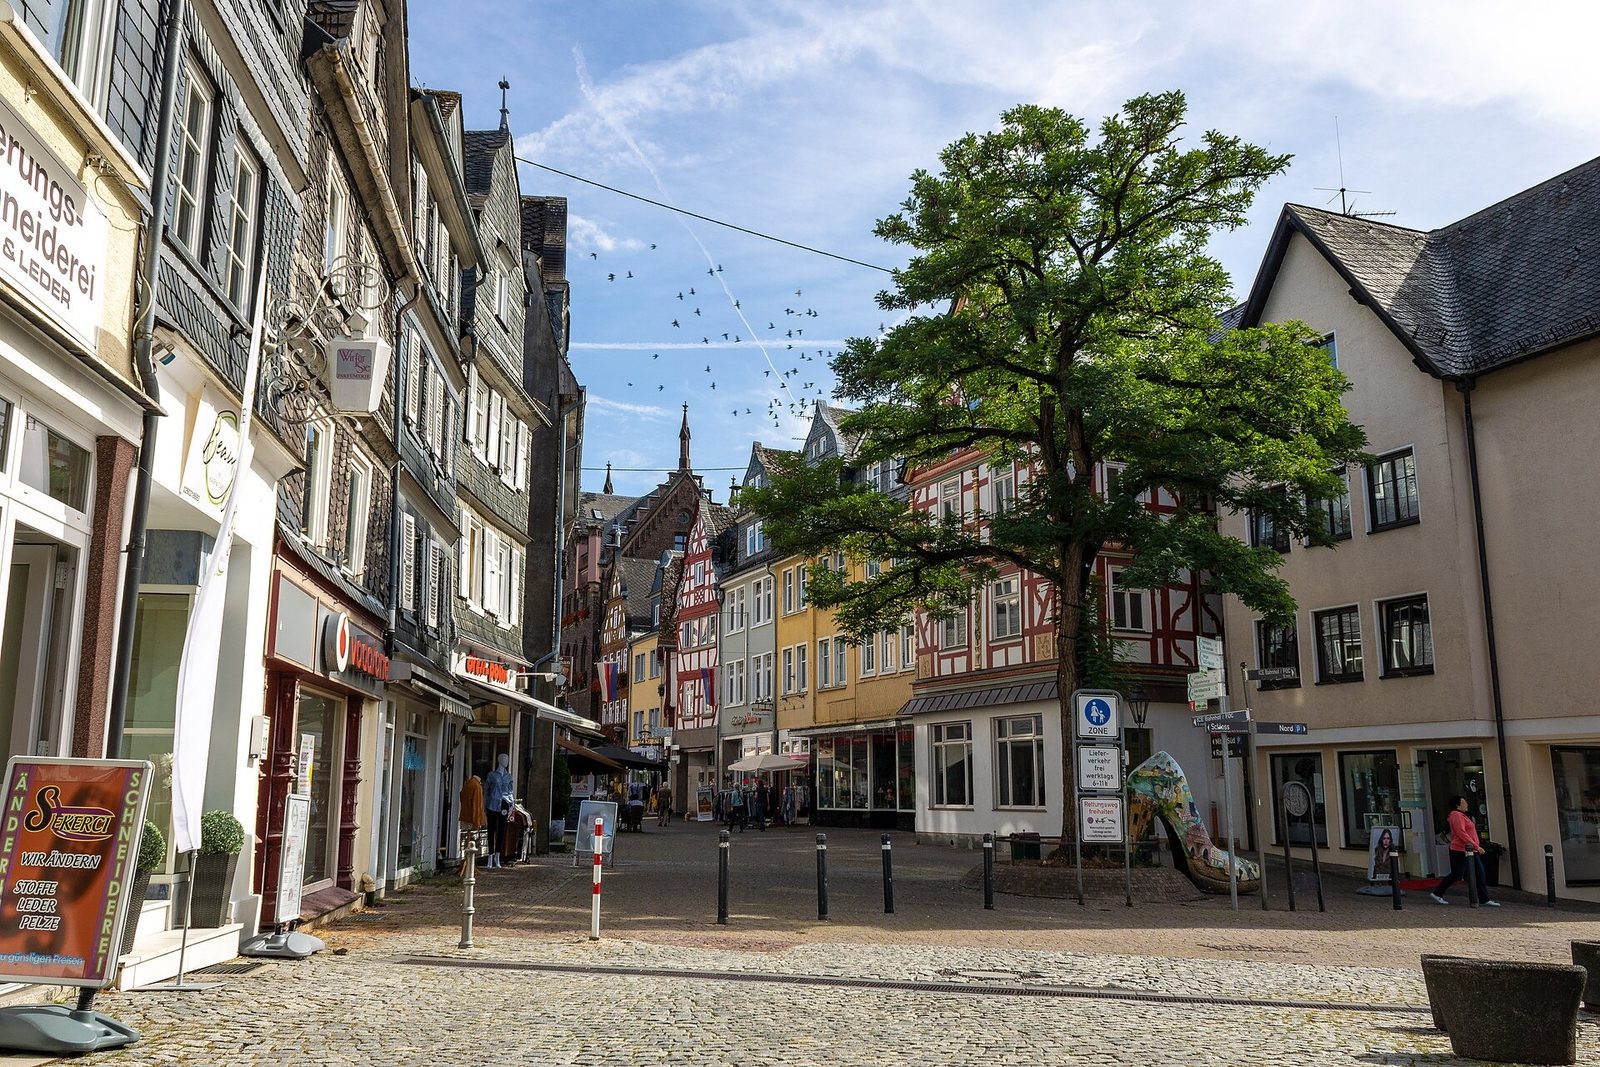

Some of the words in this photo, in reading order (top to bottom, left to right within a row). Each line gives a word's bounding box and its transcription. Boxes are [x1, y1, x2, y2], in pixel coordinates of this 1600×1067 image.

[0, 188, 95, 301] neiderei
[2, 237, 16, 262] &
[19, 249, 71, 310] LEDER
[24, 785, 112, 834] SEKERCI
[1084, 801, 1119, 809] Rettungsweg
[21, 852, 46, 867] WIR
[46, 850, 101, 869] ÄNDERN
[96, 772, 141, 974] SCHNEIDEREI
[13, 880, 58, 896] STOFFE
[16, 897, 57, 913] LEDER
[19, 914, 60, 931] PELZE
[8, 952, 51, 964] günstigen
[52, 954, 83, 966] Preisen
